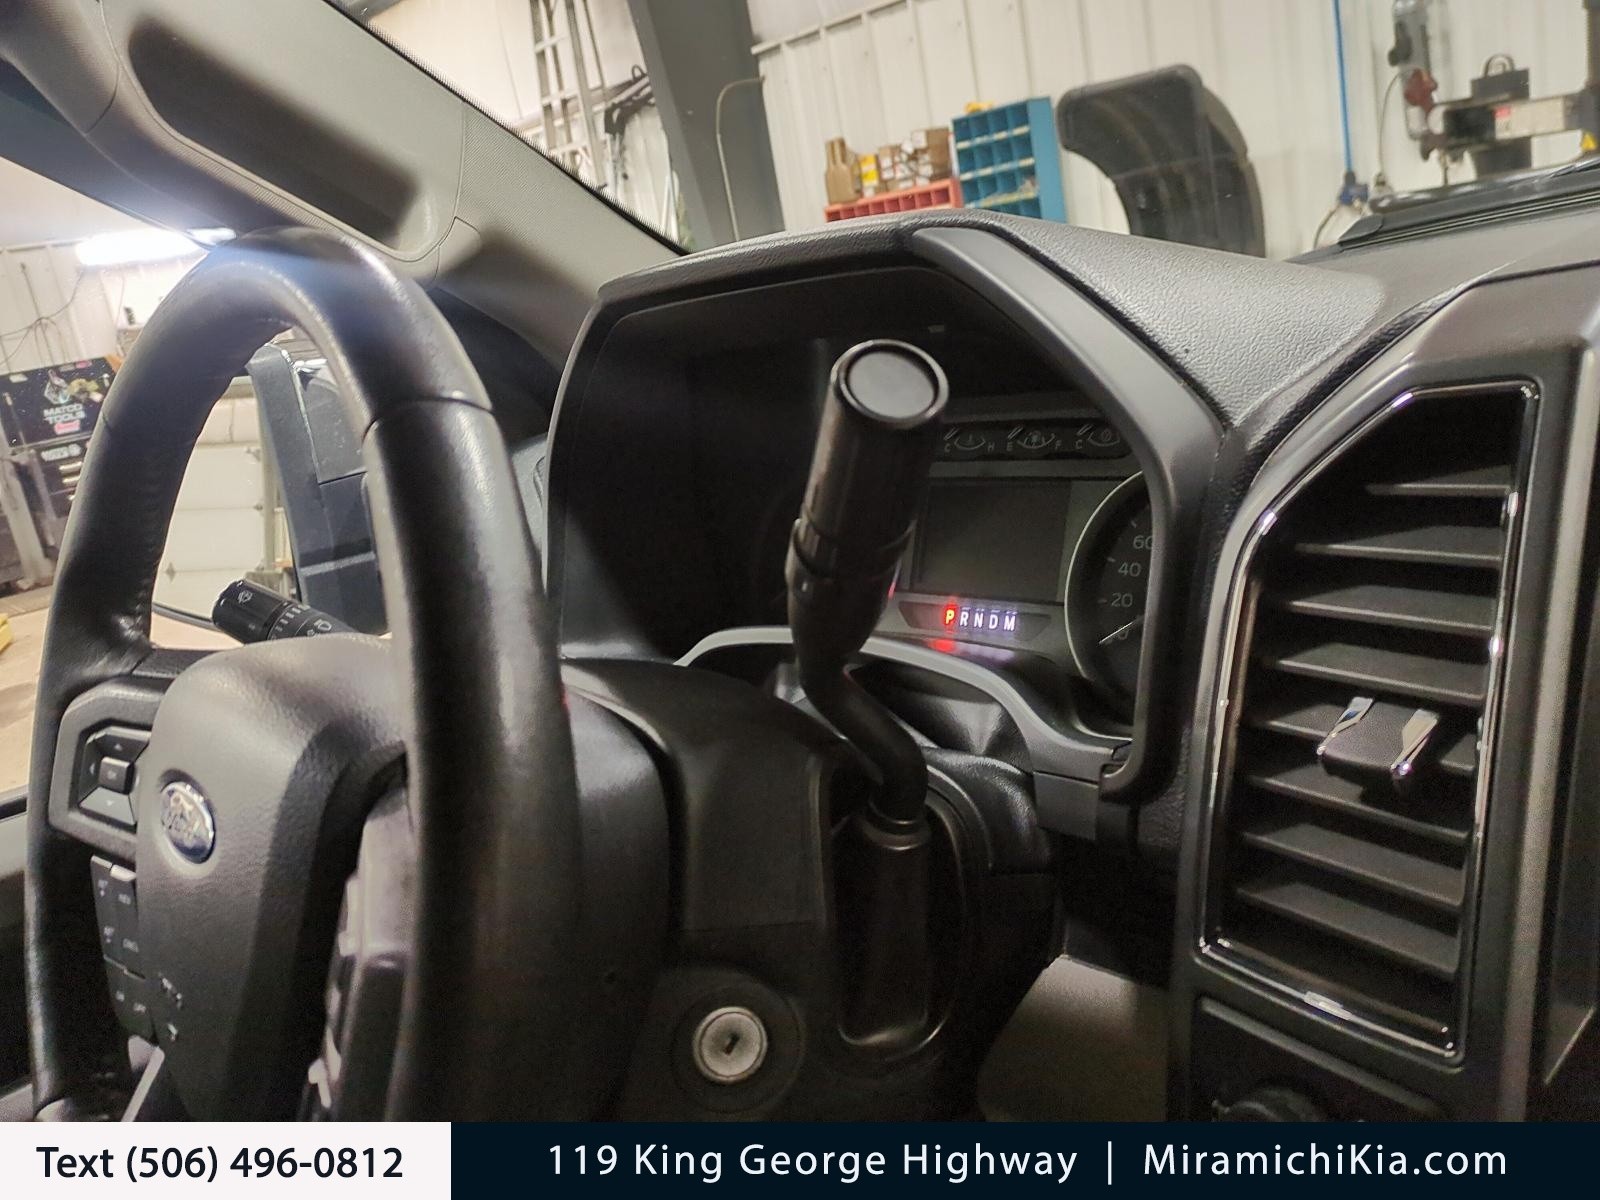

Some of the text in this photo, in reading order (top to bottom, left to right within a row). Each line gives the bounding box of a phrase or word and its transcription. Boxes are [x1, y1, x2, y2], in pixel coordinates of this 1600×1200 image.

[43, 403, 83, 417] MATCO
[1118, 562, 1141, 577] 40
[1111, 593, 1133, 608] 20
